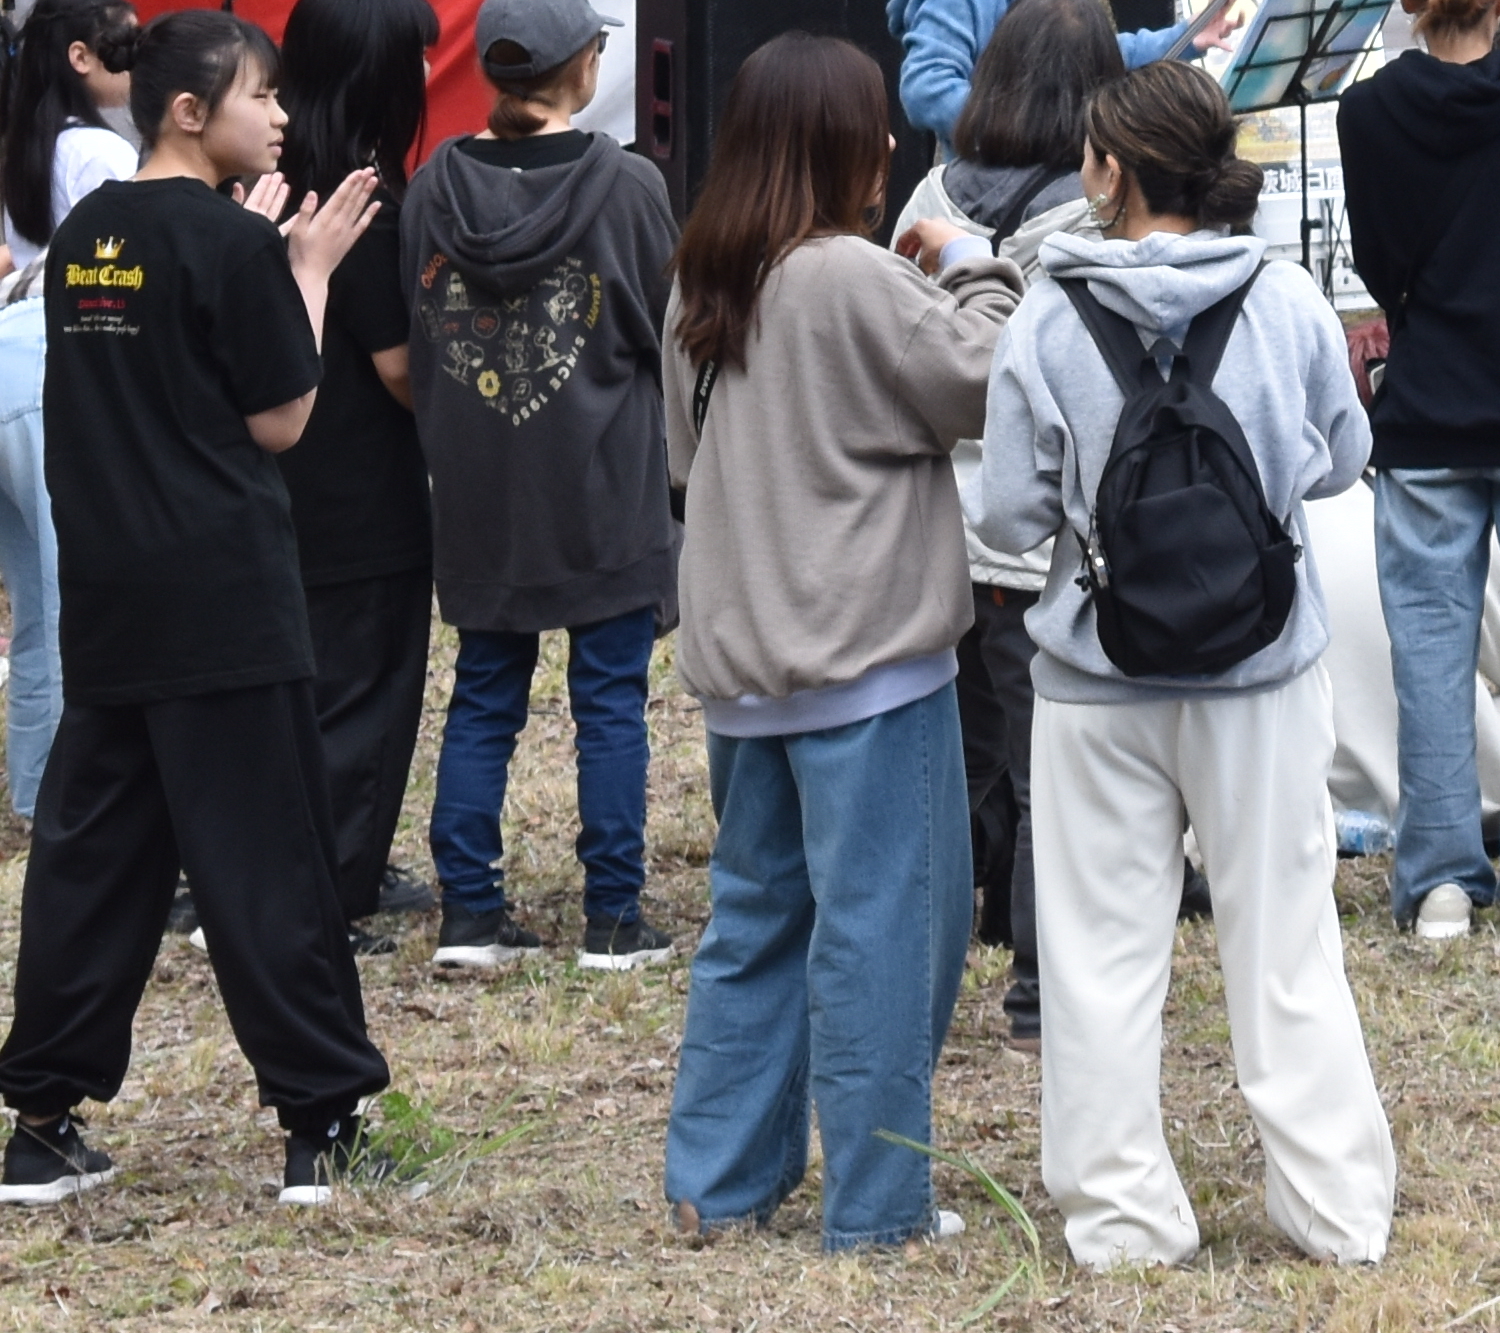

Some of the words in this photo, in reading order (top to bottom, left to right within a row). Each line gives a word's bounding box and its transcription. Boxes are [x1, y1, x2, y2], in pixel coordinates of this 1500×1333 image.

[65, 263, 98, 289] Beat
[98, 264, 144, 291] Crash
[549, 335, 586, 391] SINCE
[512, 391, 549, 427] 1950
